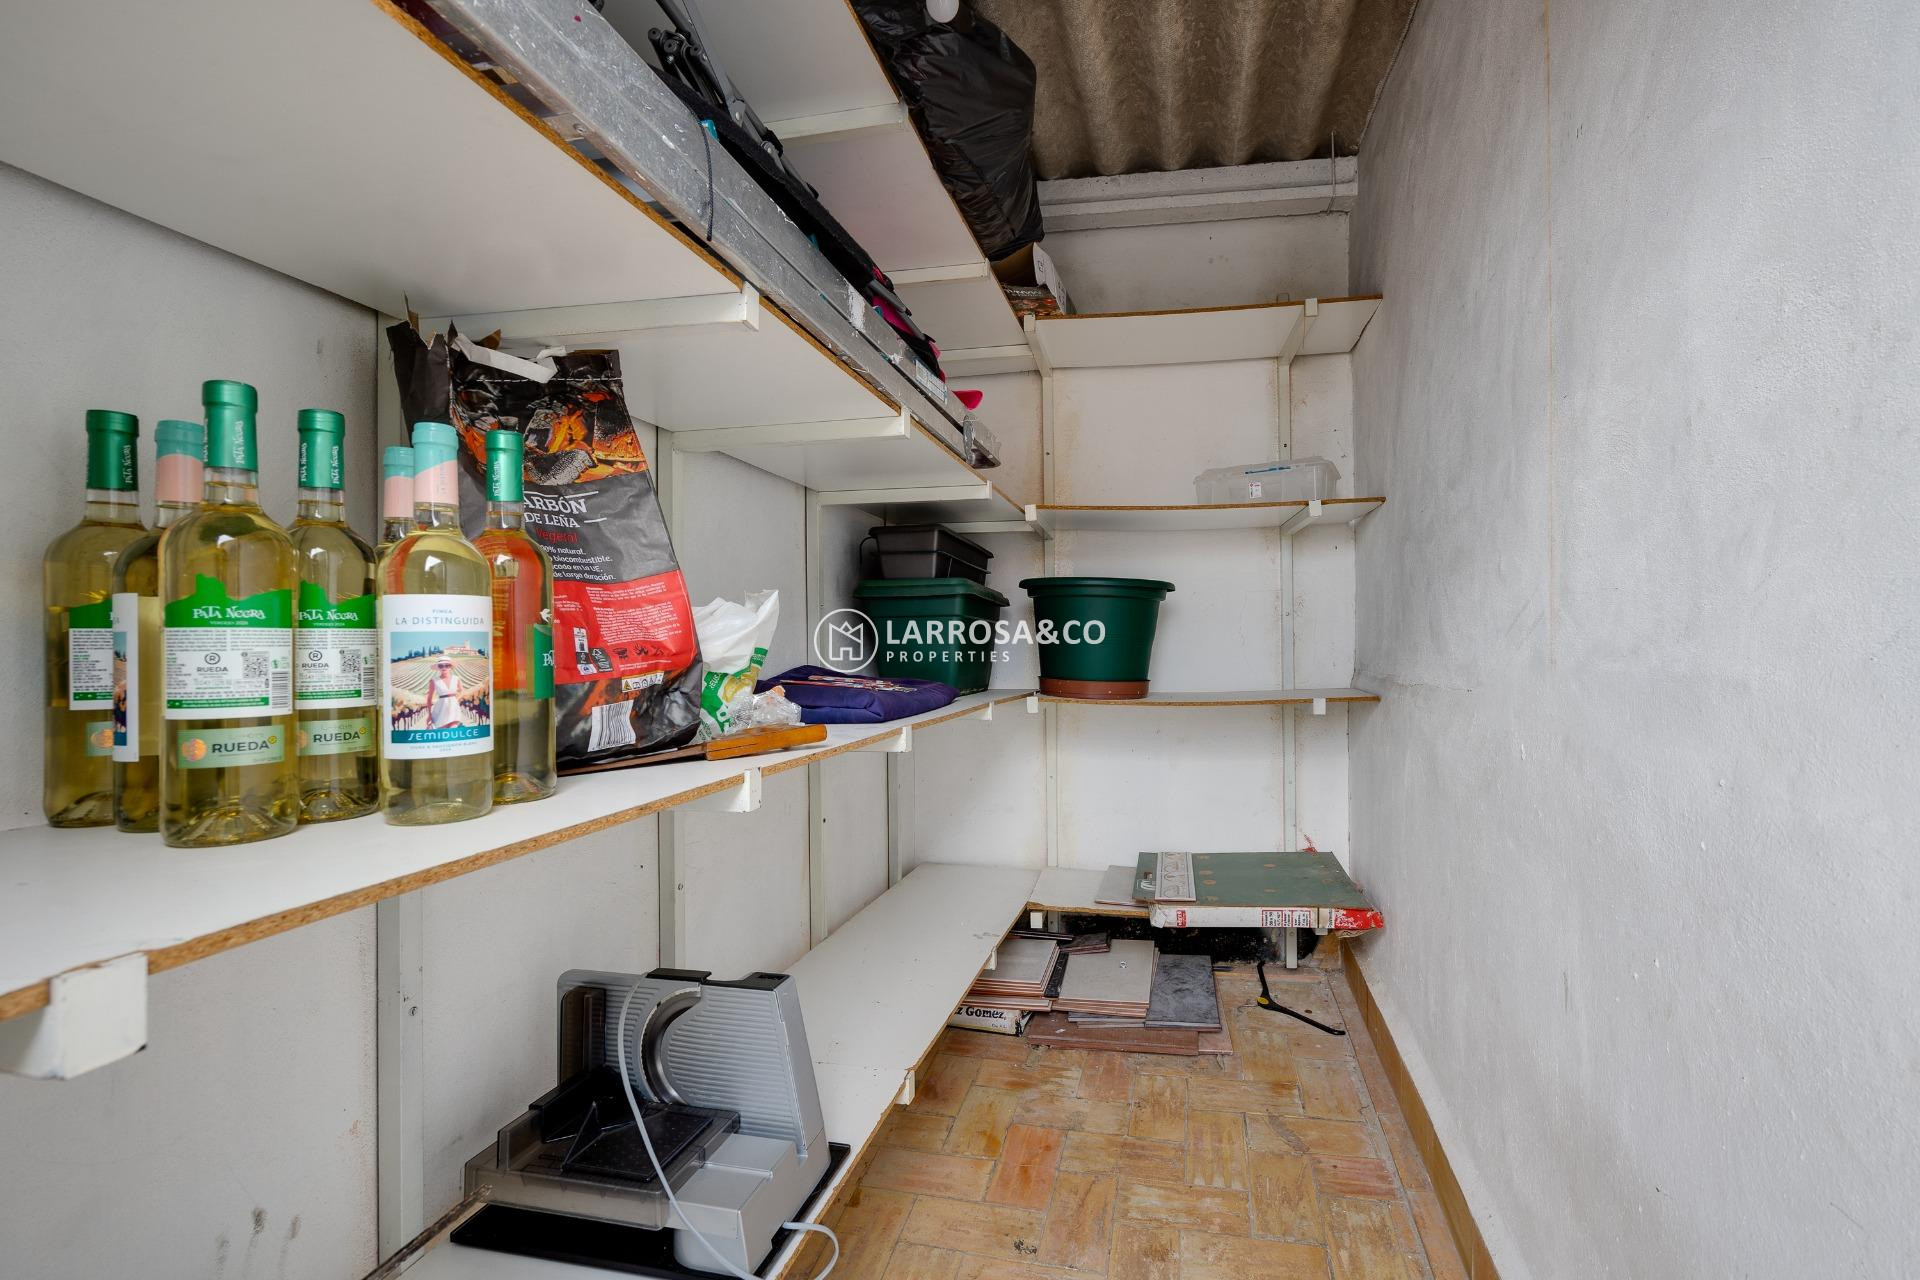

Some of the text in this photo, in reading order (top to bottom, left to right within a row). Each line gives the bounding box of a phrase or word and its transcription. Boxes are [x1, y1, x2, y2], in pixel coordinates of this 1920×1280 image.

[523, 496, 588, 515] ARBÓN
[524, 512, 581, 528] DE LEÑA
[395, 616, 484, 625] LA DISTINGUIDA
[313, 731, 360, 743] RUEDA
[408, 728, 479, 741] SEMIDULCE
[211, 740, 270, 754] RUEDA
